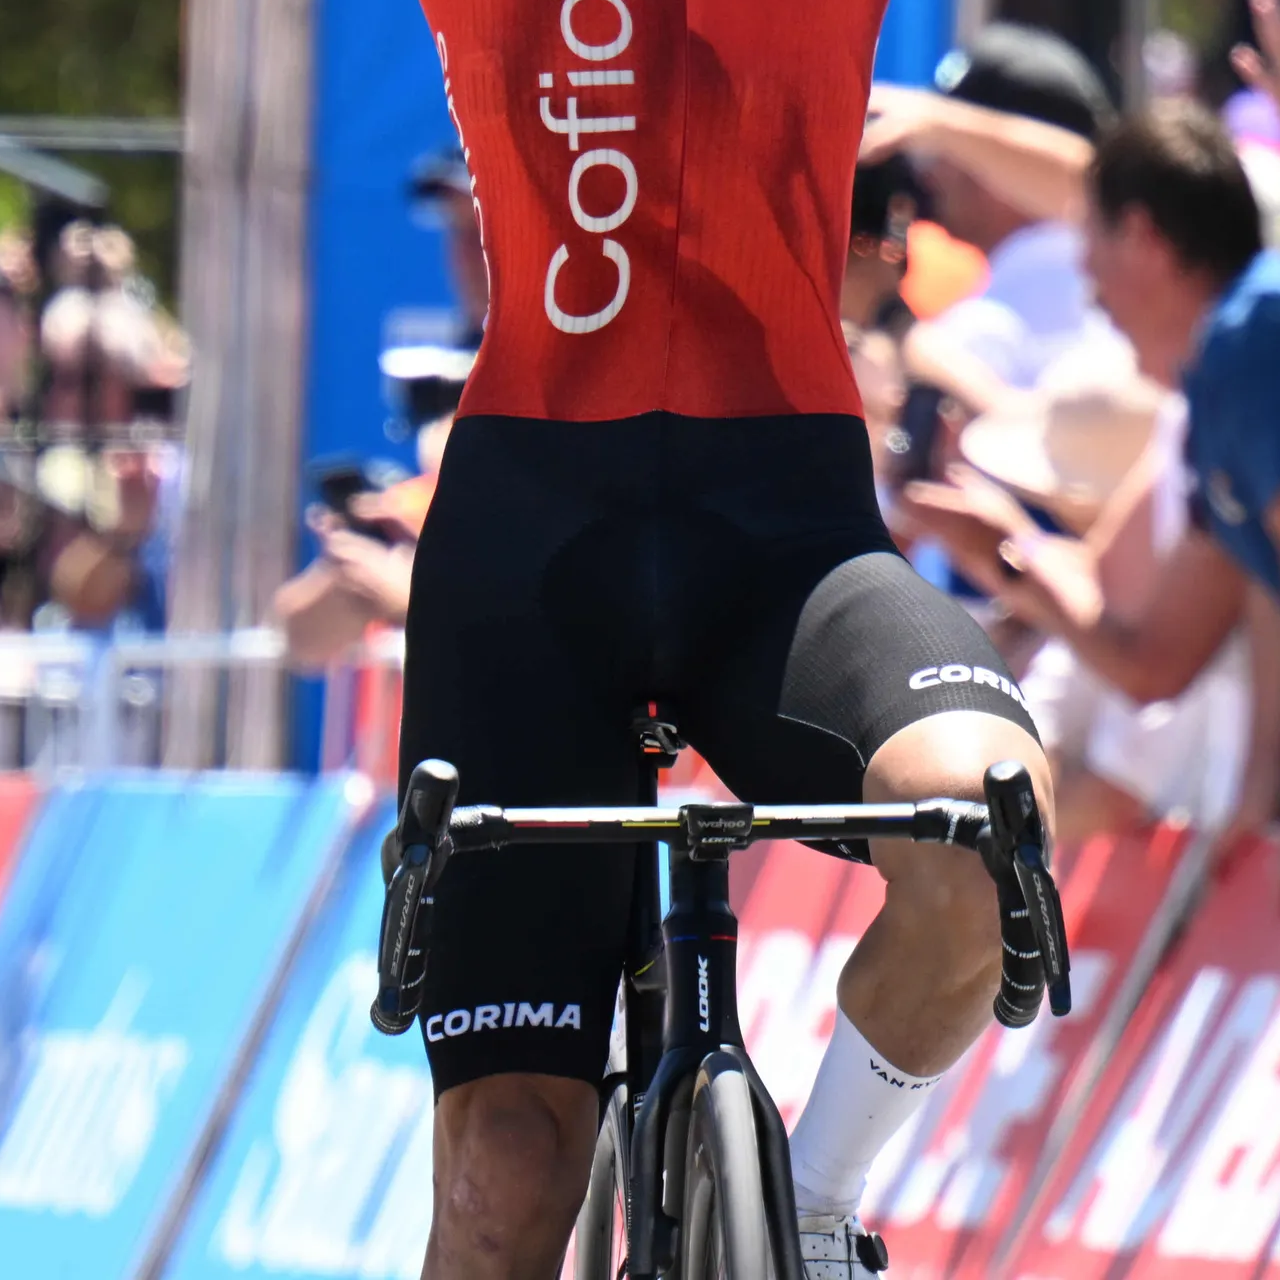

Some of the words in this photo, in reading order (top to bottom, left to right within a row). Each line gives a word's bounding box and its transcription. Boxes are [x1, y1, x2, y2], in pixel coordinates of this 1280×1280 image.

[697, 818, 746, 832] wahoo
[391, 874, 415, 977] DURA-ACE
[1032, 872, 1060, 976] DURA-ACE
[426, 1002, 581, 1042] CORIMA
[698, 954, 709, 1033] LOOK
[869, 1058, 905, 1088] VAN
